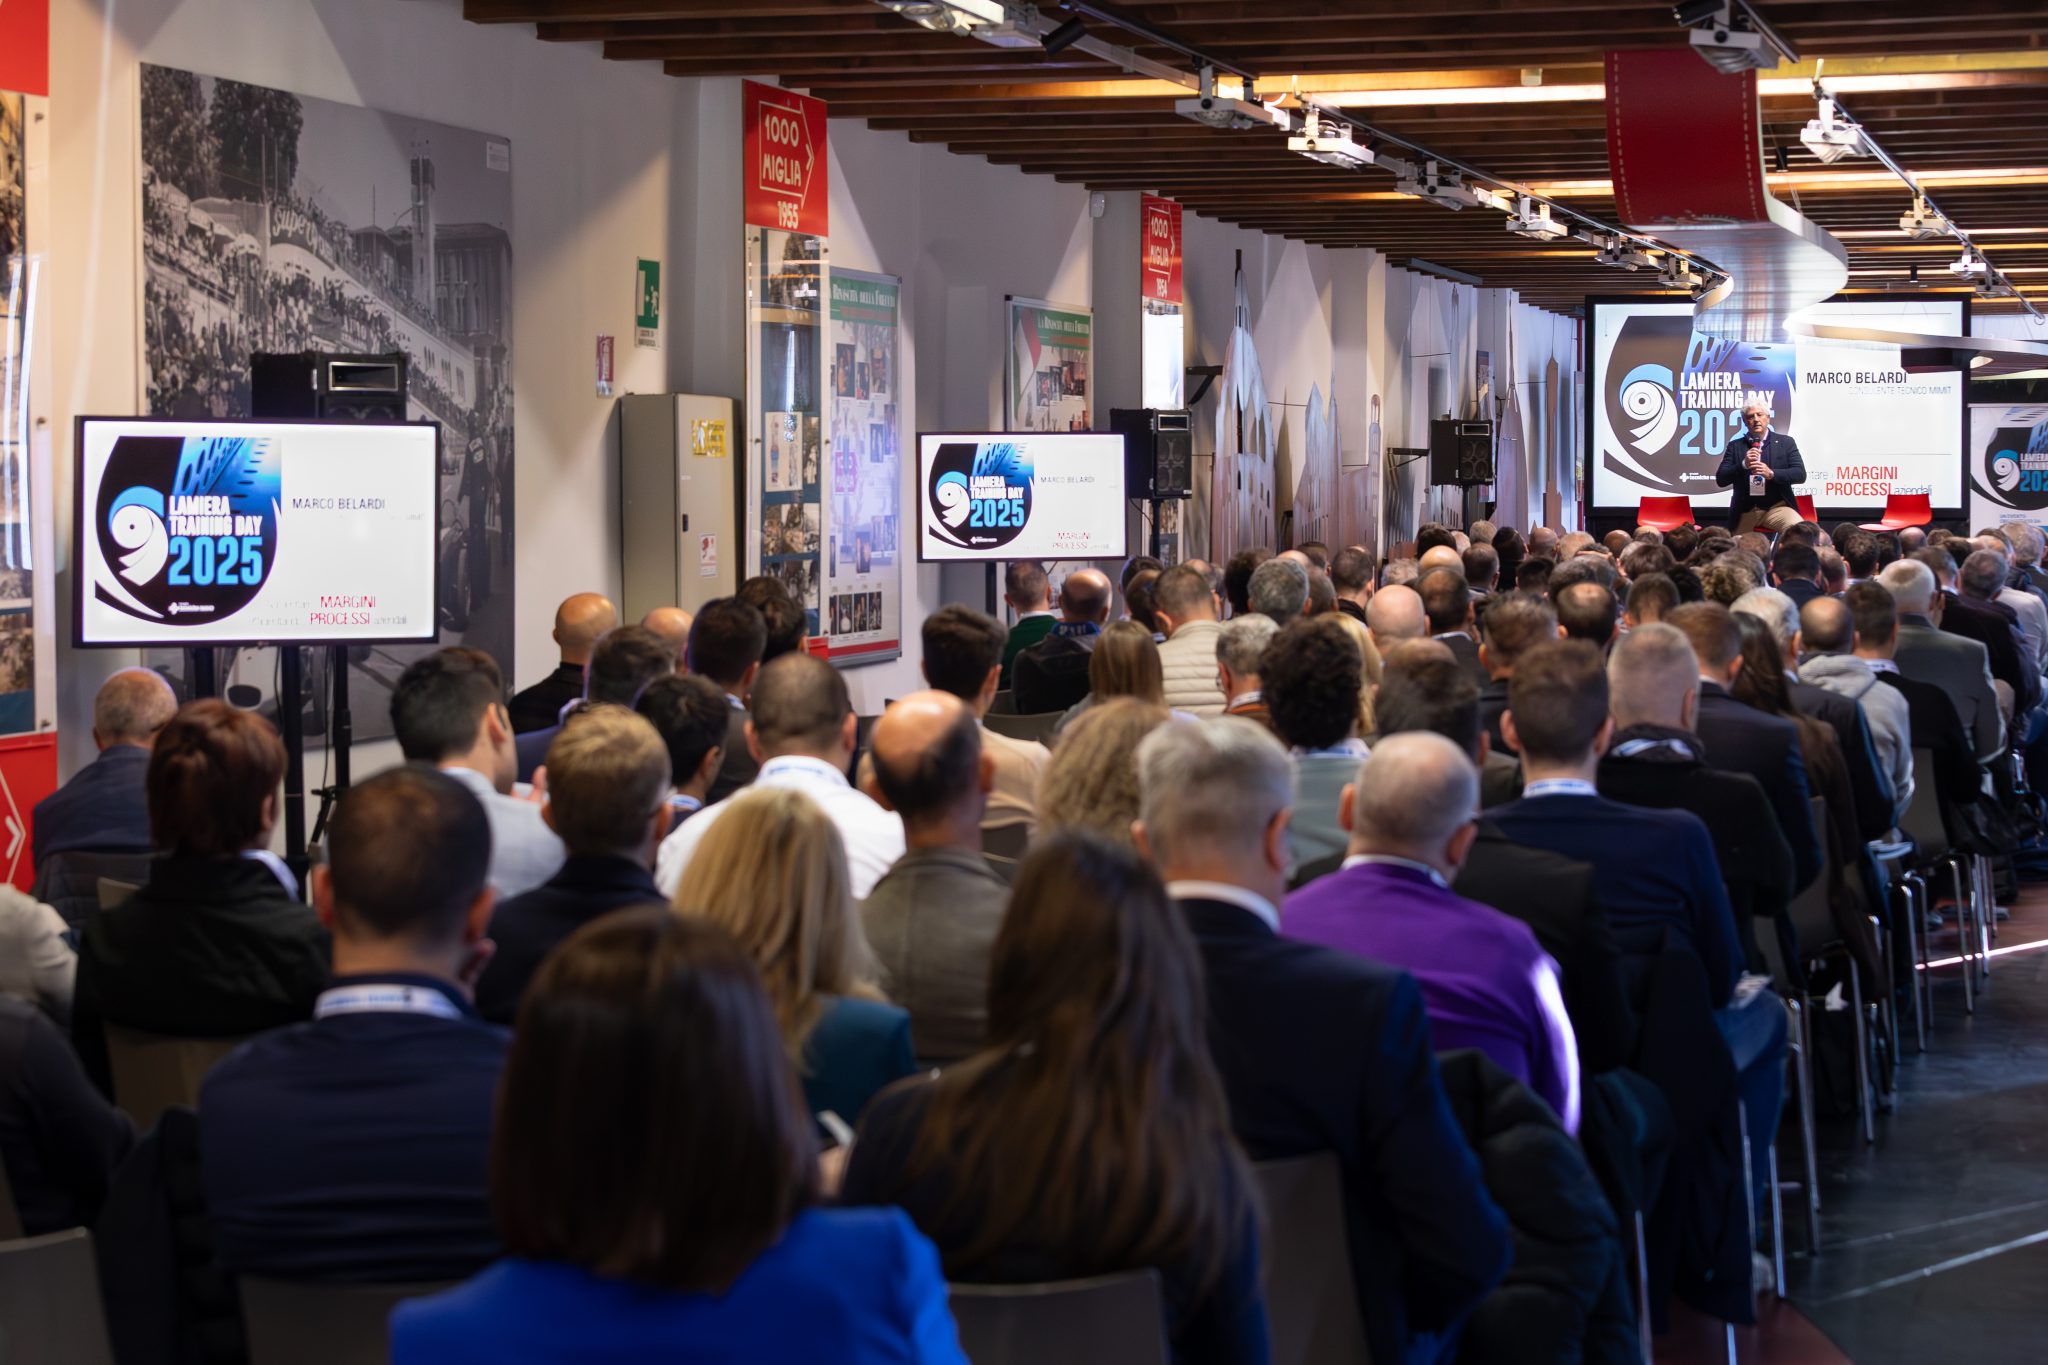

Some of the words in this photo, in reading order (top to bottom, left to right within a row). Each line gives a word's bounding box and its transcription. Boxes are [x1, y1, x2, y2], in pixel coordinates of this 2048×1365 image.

[764, 114, 800, 148] 1000
[762, 153, 802, 187] MIGLIA
[777, 200, 799, 230] 1955
[1151, 216, 1169, 239] 1000
[1150, 244, 1169, 267] MIGLIA
[1680, 371, 1742, 390] LAMIERA
[1806, 371, 1851, 384] MARCO
[1855, 371, 1907, 384] BELARDI
[1680, 390, 1744, 409] TRAINING
[1679, 409, 1775, 455] 202
[969, 475, 1006, 488] LAMIERA
[1040, 476, 1066, 484] MARCO
[1836, 466, 1898, 480] MARGINI
[969, 487, 1007, 499] TRAINING
[1007, 487, 1025, 499] DAY
[1825, 482, 1892, 496] PROCESSI
[168, 495, 231, 516] LAMIERA
[292, 498, 334, 510] MARCO
[338, 498, 385, 510] BELARDI
[969, 499, 1025, 528] 2025
[168, 515, 233, 536] TRAINING
[235, 515, 263, 536] DAY
[168, 536, 263, 586] 2025
[320, 595, 377, 609] MARGINI
[310, 612, 371, 625] PROCESSI
